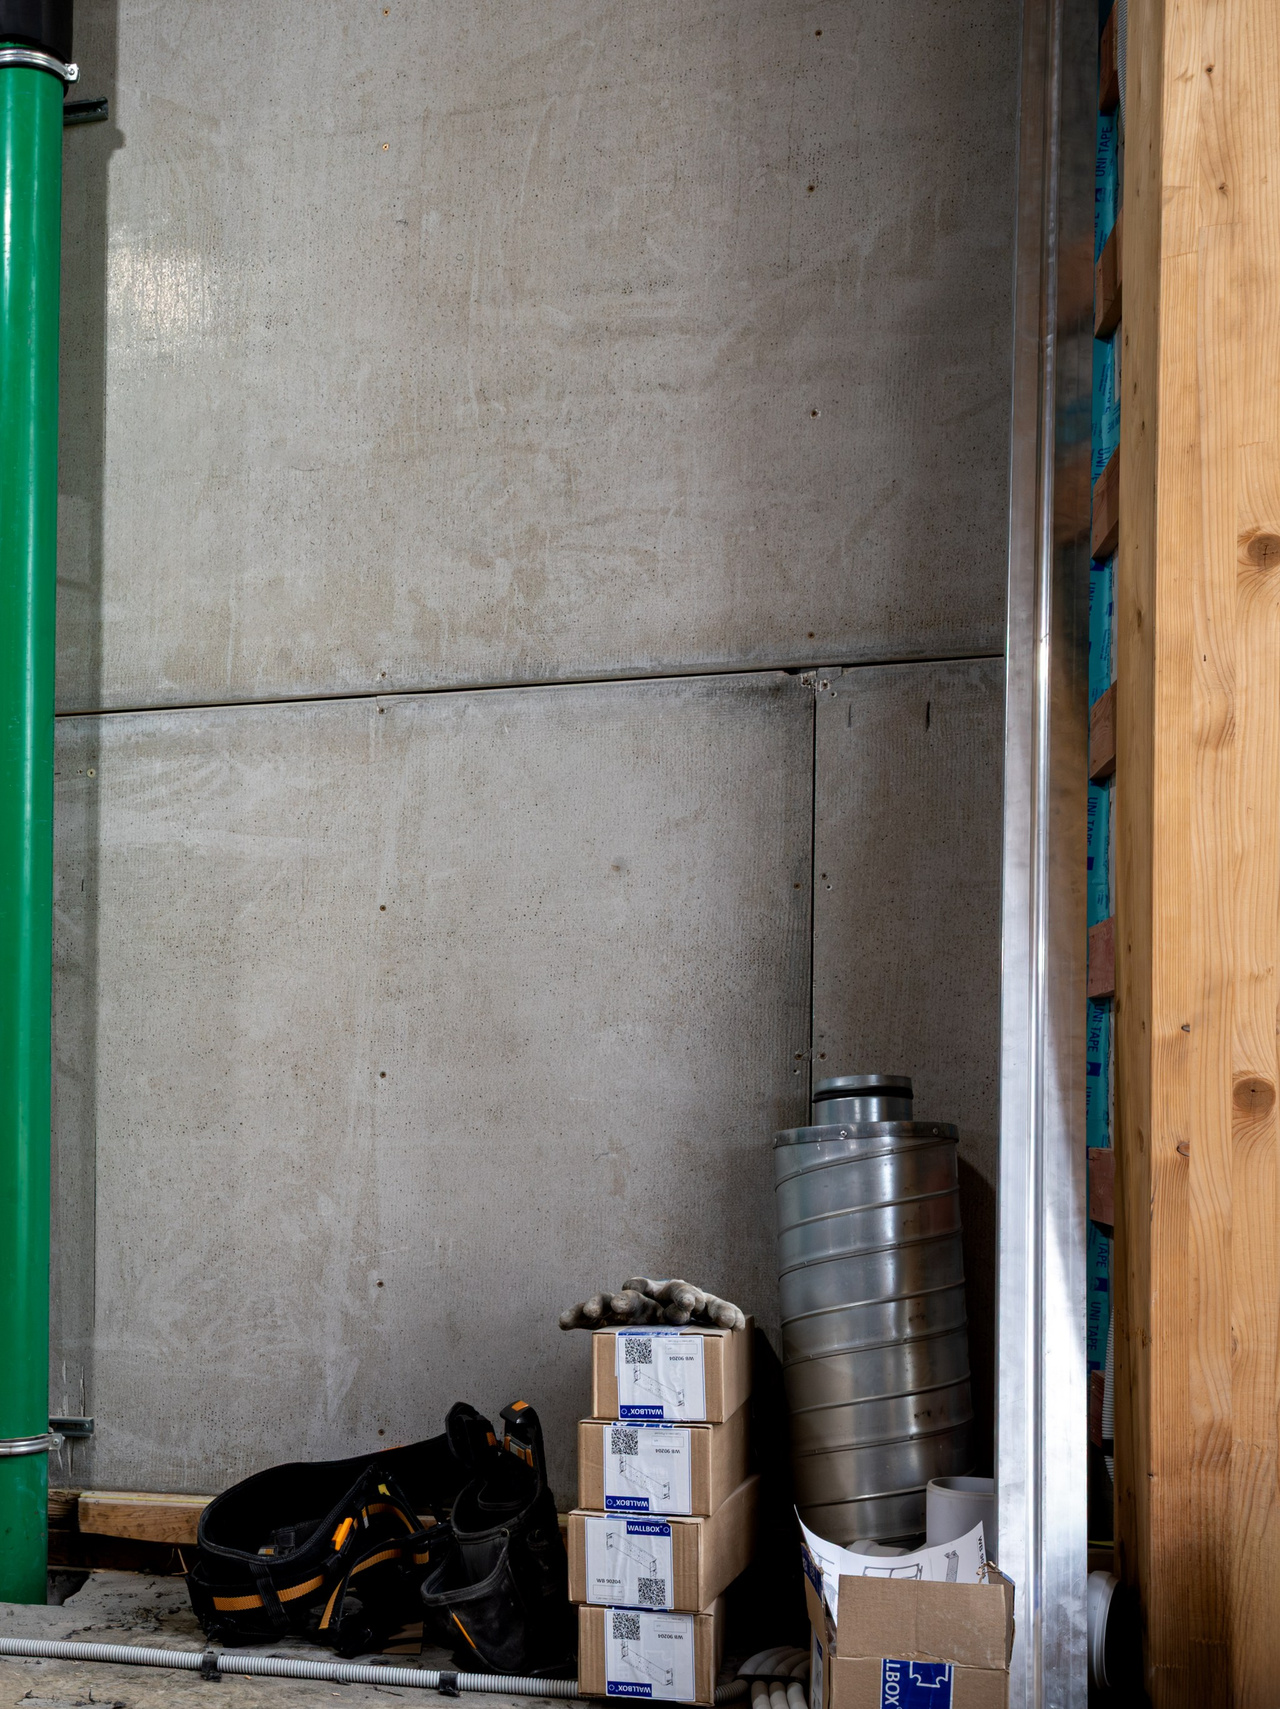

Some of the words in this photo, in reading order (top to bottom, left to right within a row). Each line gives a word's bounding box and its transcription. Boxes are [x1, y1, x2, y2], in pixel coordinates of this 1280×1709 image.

[1098, 126, 1112, 153] TAPE
[1096, 157, 1108, 177] UNI
[1093, 1003, 1105, 1023] UNI
[1088, 1026, 1102, 1053] TAPE
[1090, 1302, 1101, 1321] UNI
[1087, 1325, 1099, 1350] TAPE
